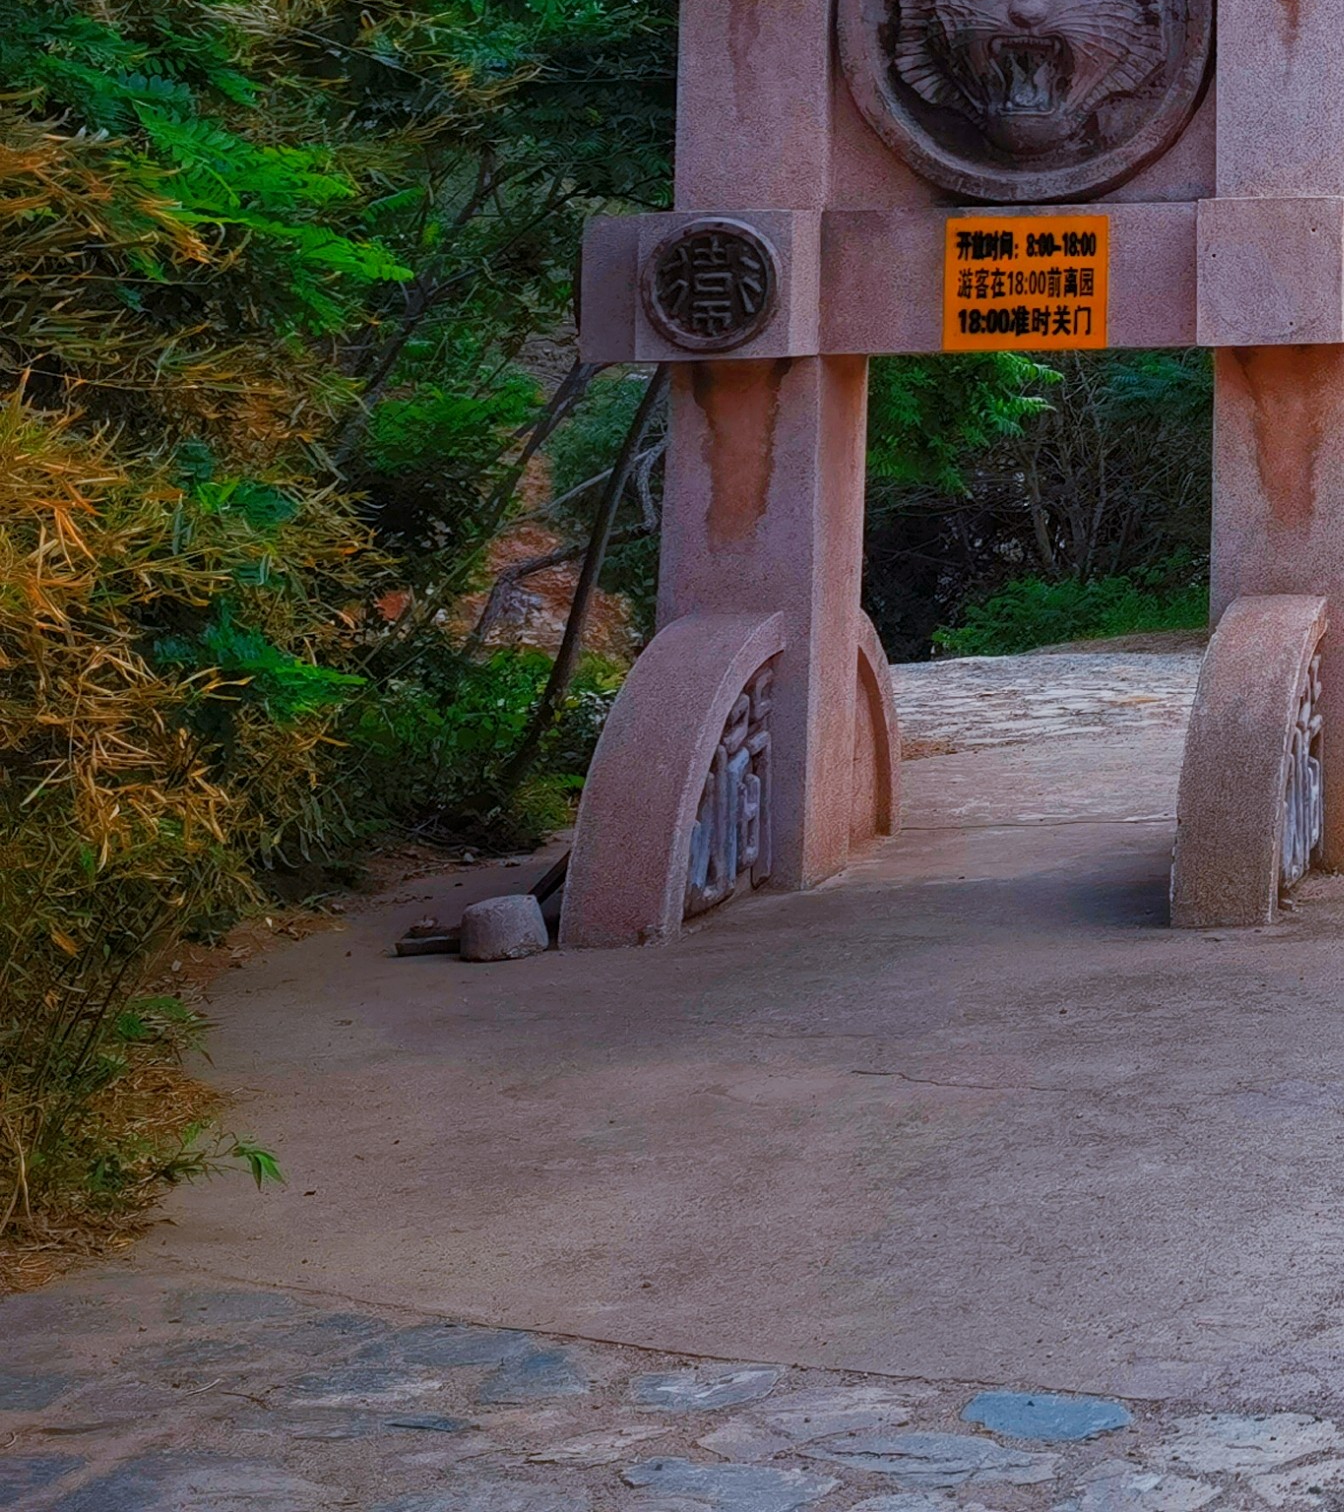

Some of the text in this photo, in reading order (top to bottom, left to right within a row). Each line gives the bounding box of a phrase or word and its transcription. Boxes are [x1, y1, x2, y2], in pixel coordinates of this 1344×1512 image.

[957, 267, 1094, 299] 游客在18:00前离园
[958, 305, 1092, 337] 18:00准时关门
